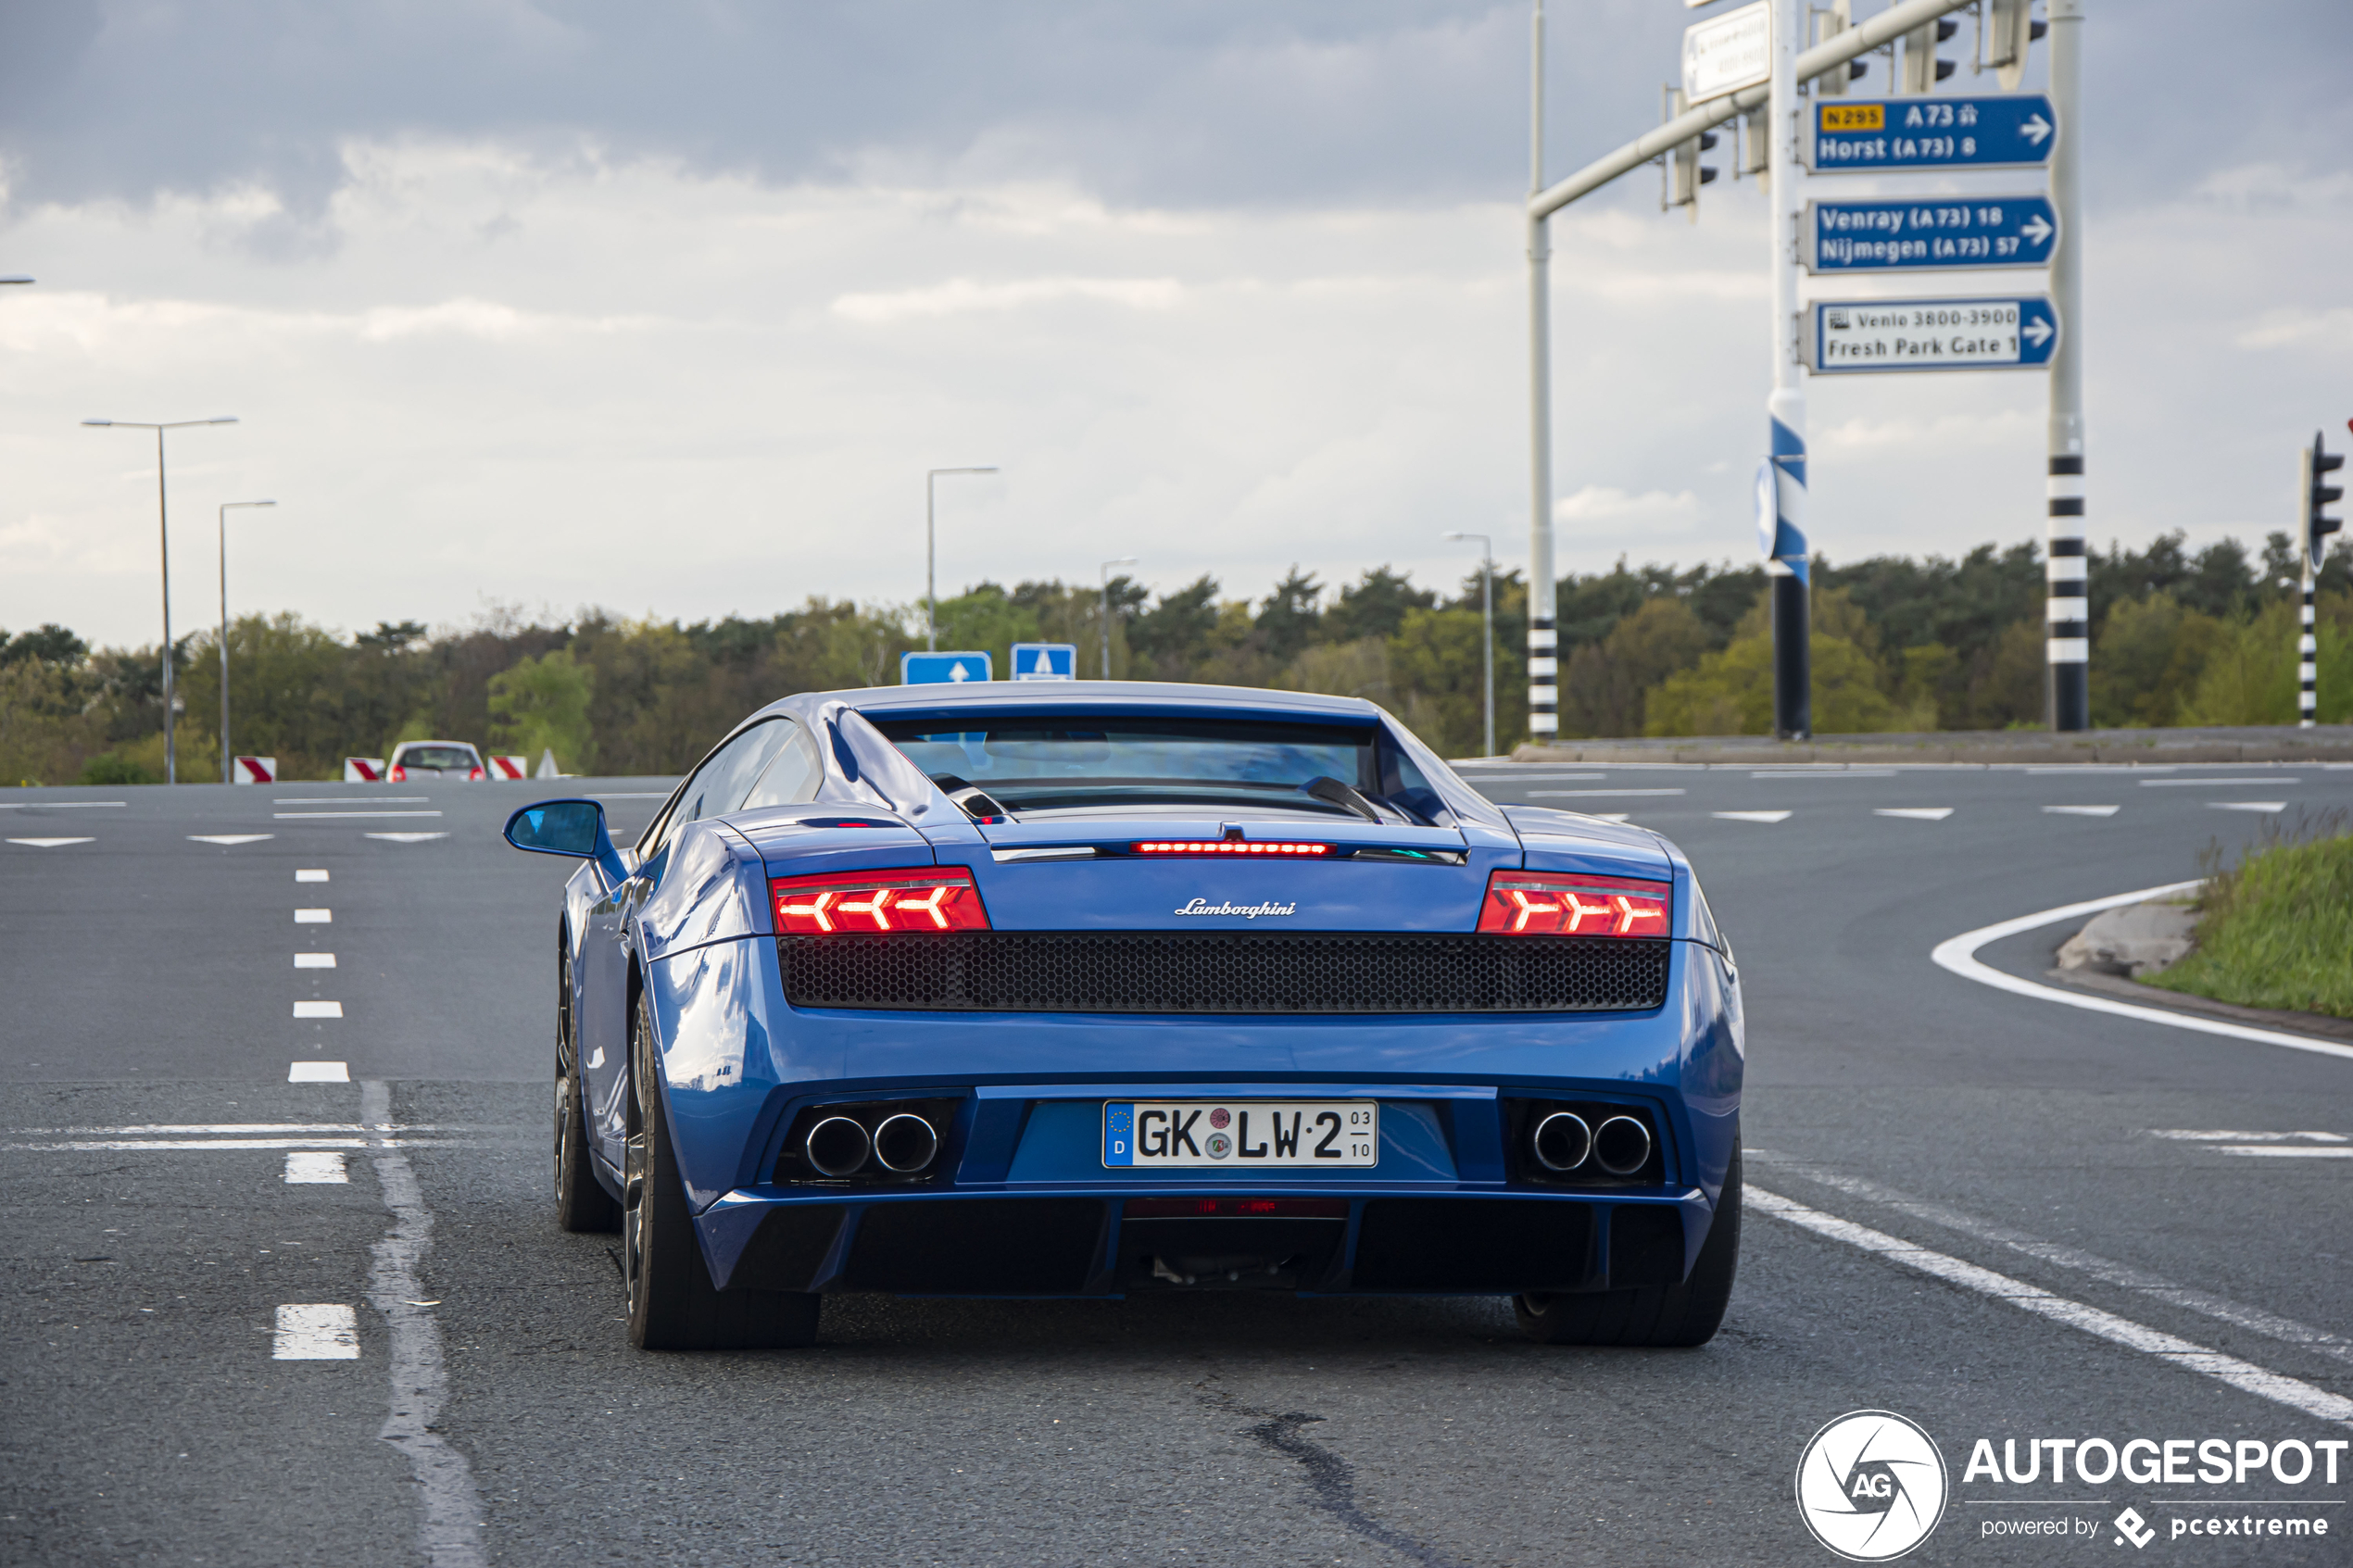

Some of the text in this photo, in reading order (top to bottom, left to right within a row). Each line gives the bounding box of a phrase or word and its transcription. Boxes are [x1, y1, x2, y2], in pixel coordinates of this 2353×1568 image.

[1827, 108, 1879, 126] N295
[1820, 137, 1886, 160] Horst
[1960, 136, 1976, 156] 8
[1820, 207, 1905, 233] Venray
[1977, 206, 2003, 226] 18
[1820, 238, 1928, 265] Nijmegen
[1994, 236, 2020, 256] 57
[1856, 308, 2017, 329] Venlo 3800-3900
[1829, 335, 2018, 357] Fresh Park Gate 1
[1174, 897, 1296, 920] Lamborghini
[1351, 1111, 1371, 1125] 03
[1138, 1110, 1342, 1159] GK LW 2
[1114, 1140, 1126, 1155] D
[1351, 1143, 1370, 1158] 10
